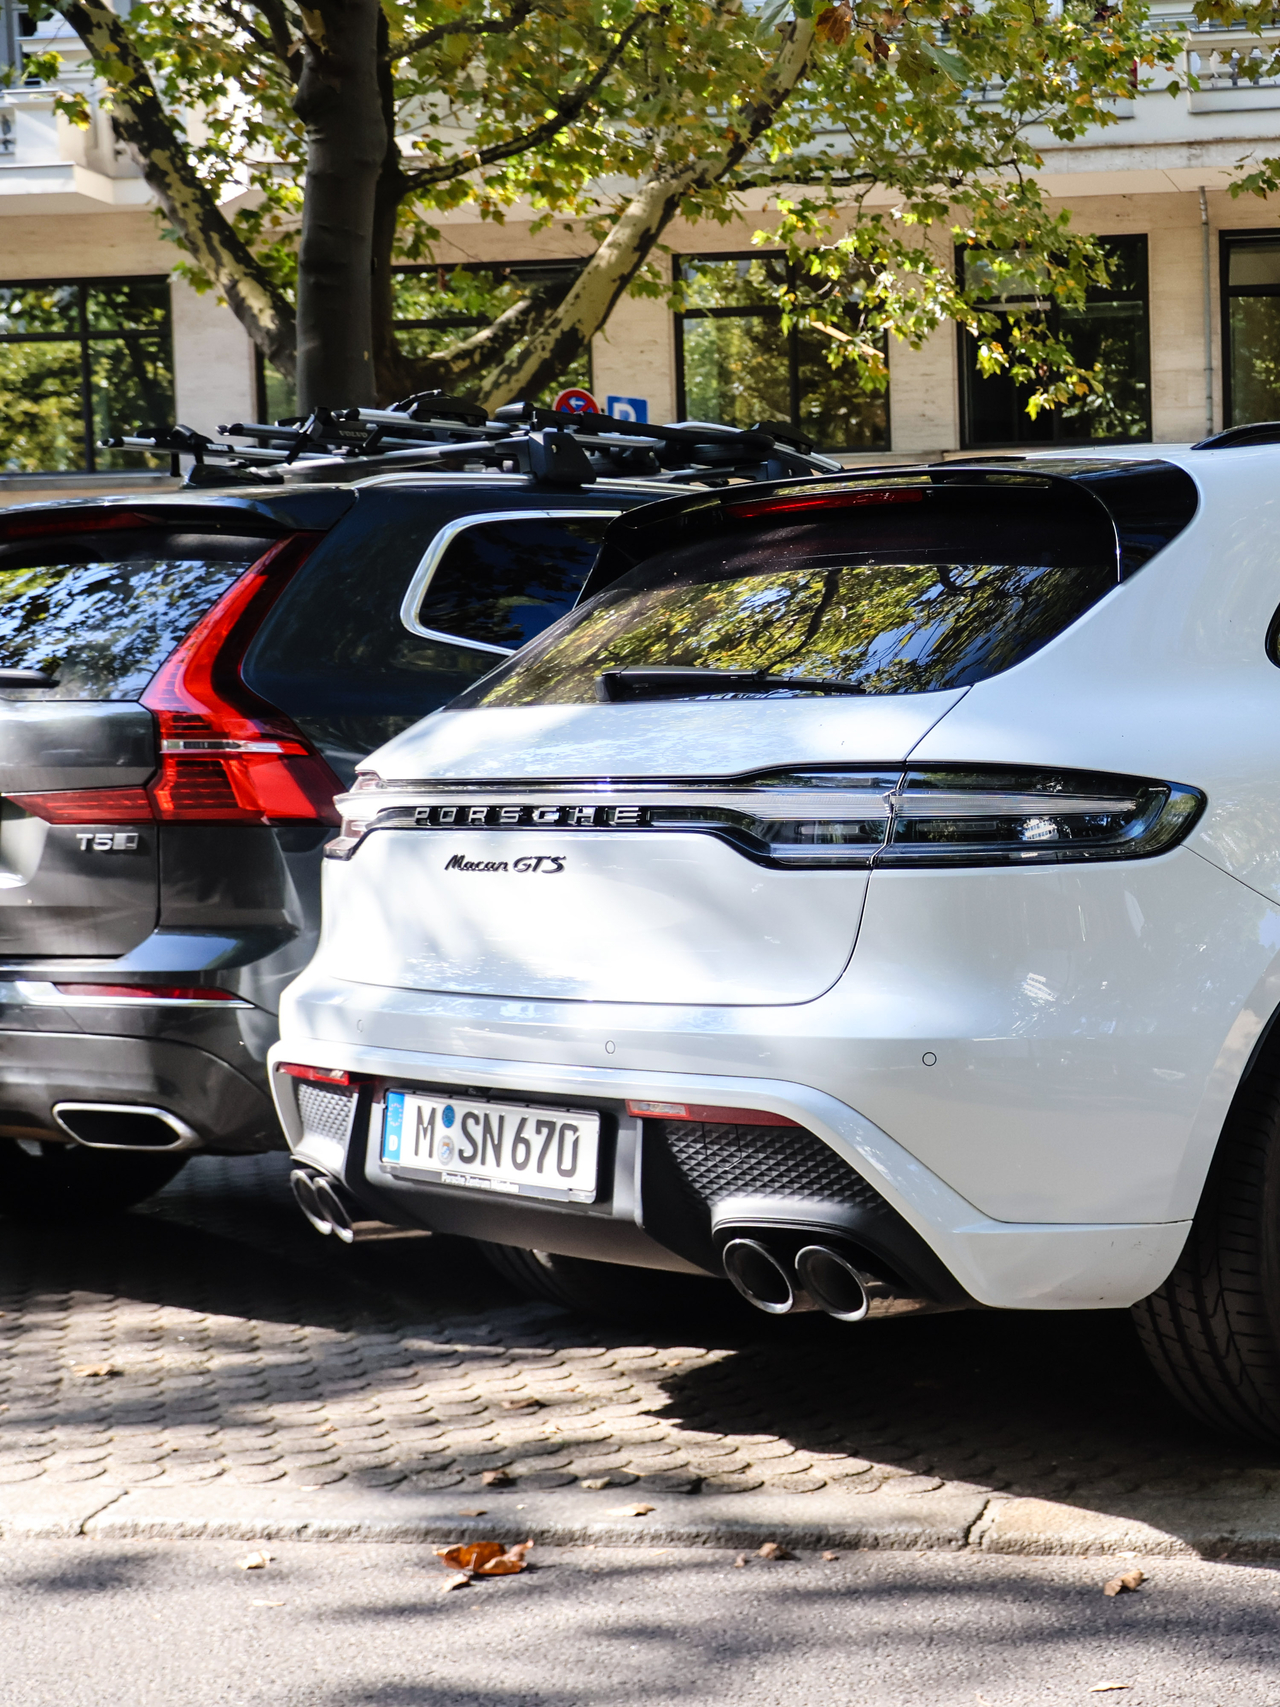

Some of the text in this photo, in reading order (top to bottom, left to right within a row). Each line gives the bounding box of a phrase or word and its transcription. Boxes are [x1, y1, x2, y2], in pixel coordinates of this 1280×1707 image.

[414, 807, 642, 824] PORSCHE
[445, 854, 567, 874] Macan GTS
[414, 1105, 437, 1159] M
